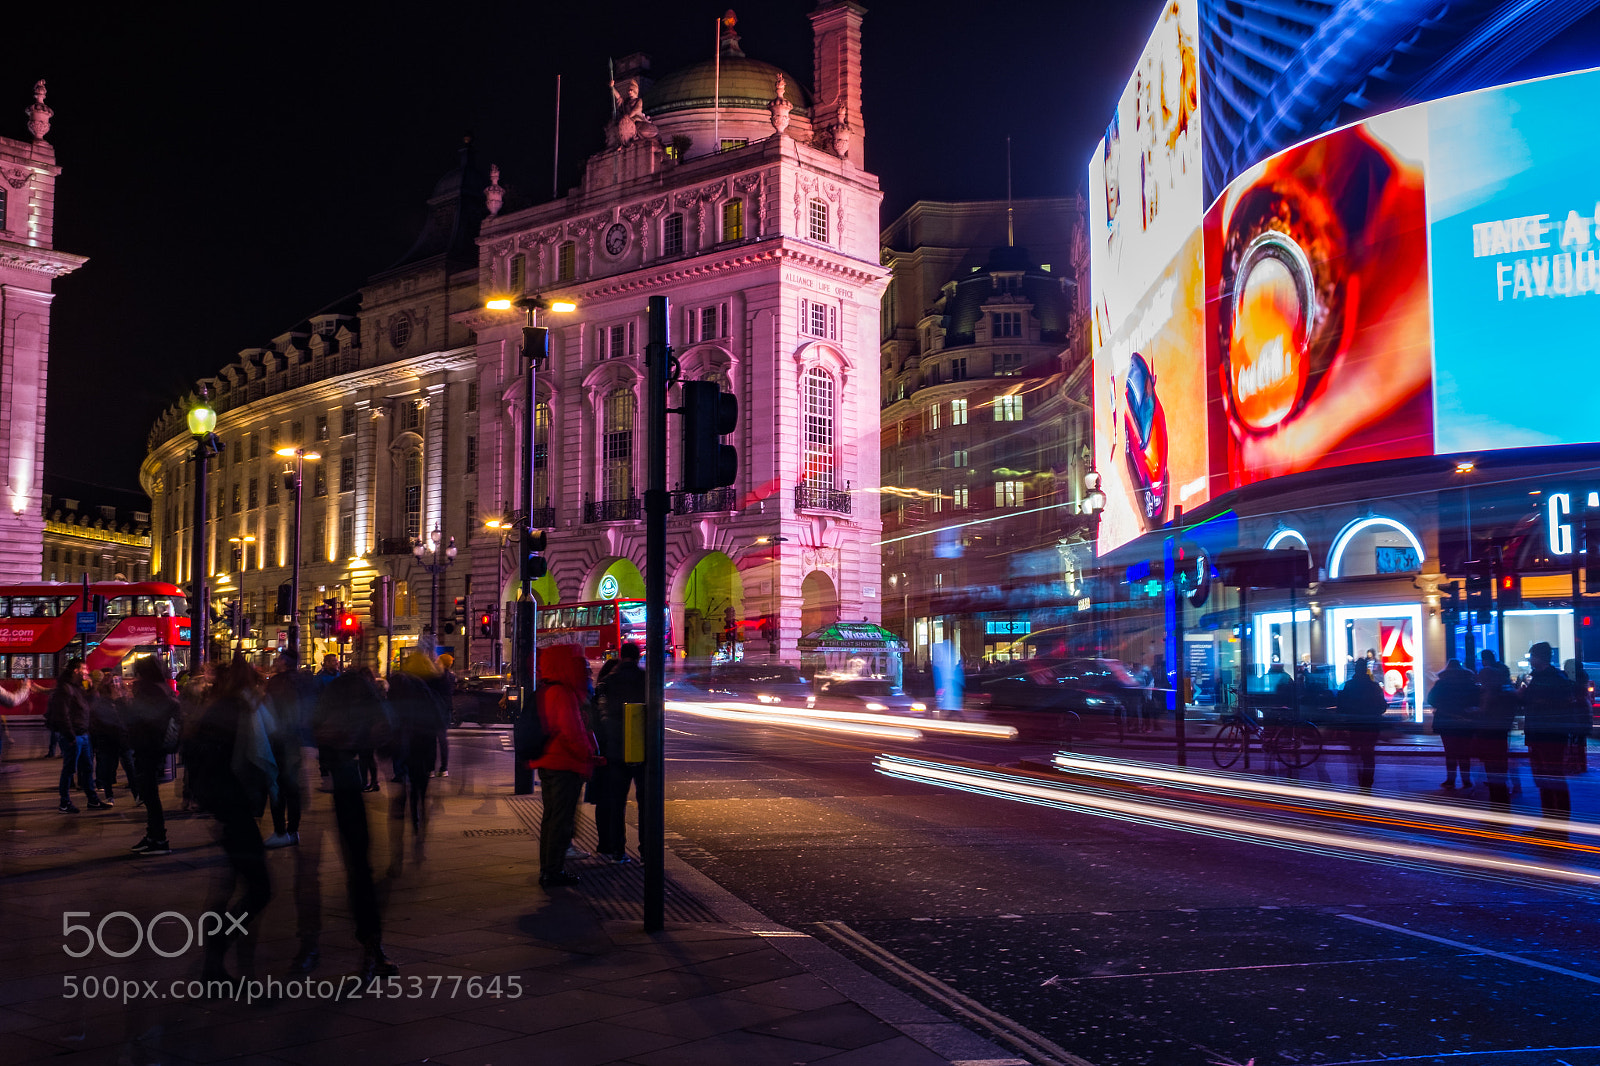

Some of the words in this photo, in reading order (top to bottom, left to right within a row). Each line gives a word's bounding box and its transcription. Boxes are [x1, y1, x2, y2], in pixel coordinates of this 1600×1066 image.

[1473, 214, 1551, 258] TAKE
[785, 273, 813, 288] ALLIANCE
[819, 281, 831, 293] LIFE
[834, 287, 854, 299] OFFICE
[838, 630, 882, 640] WICKED
